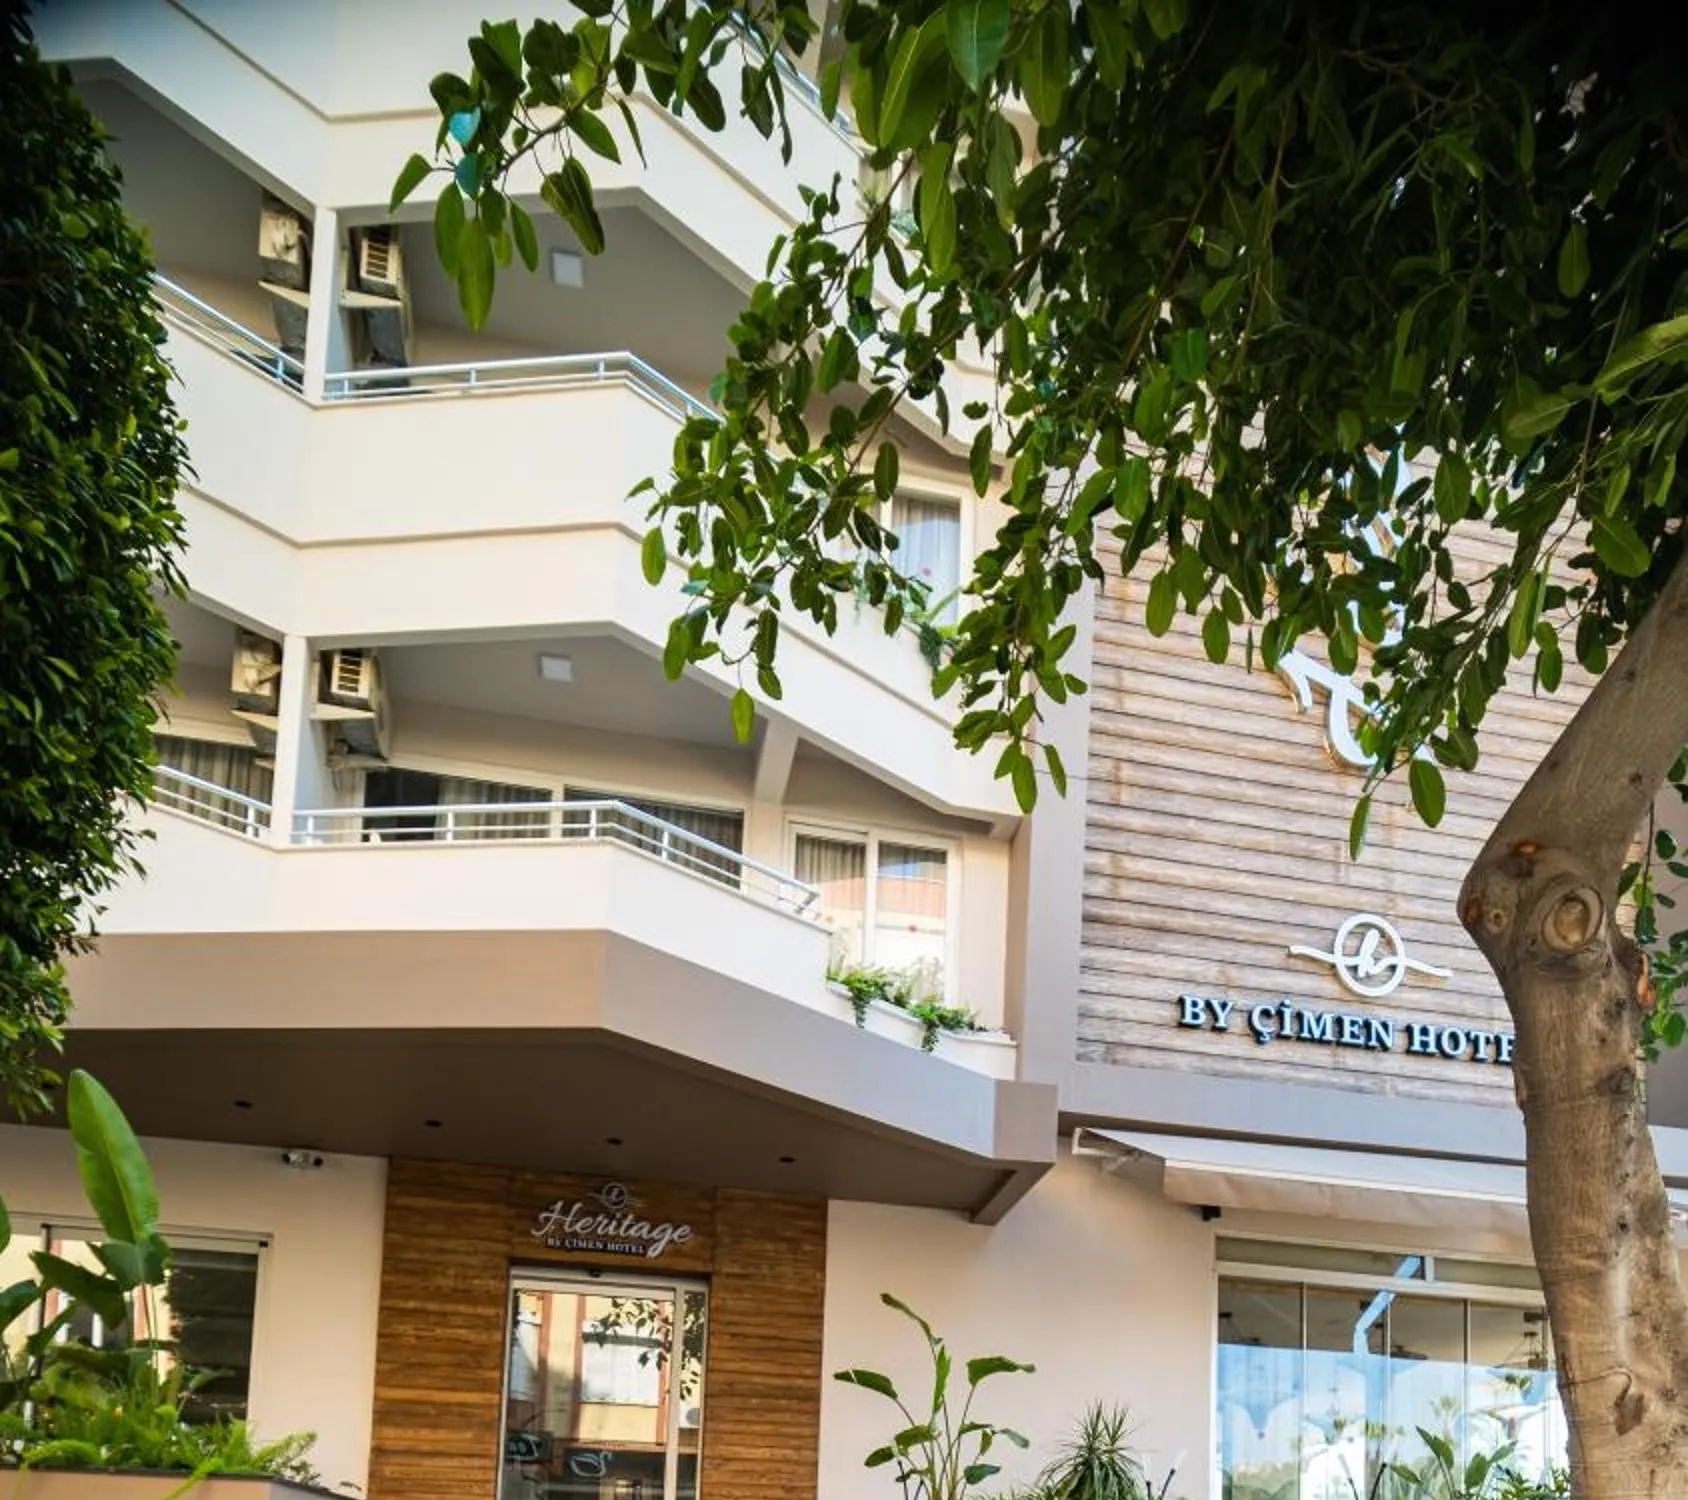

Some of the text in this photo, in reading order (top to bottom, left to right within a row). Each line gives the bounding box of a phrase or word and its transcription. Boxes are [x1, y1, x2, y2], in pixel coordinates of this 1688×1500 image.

[1181, 995, 1516, 1063] BY ÇİMEN HOTE
[530, 1200, 694, 1259] Heritage
[607, 1241, 645, 1255] HOTEL
